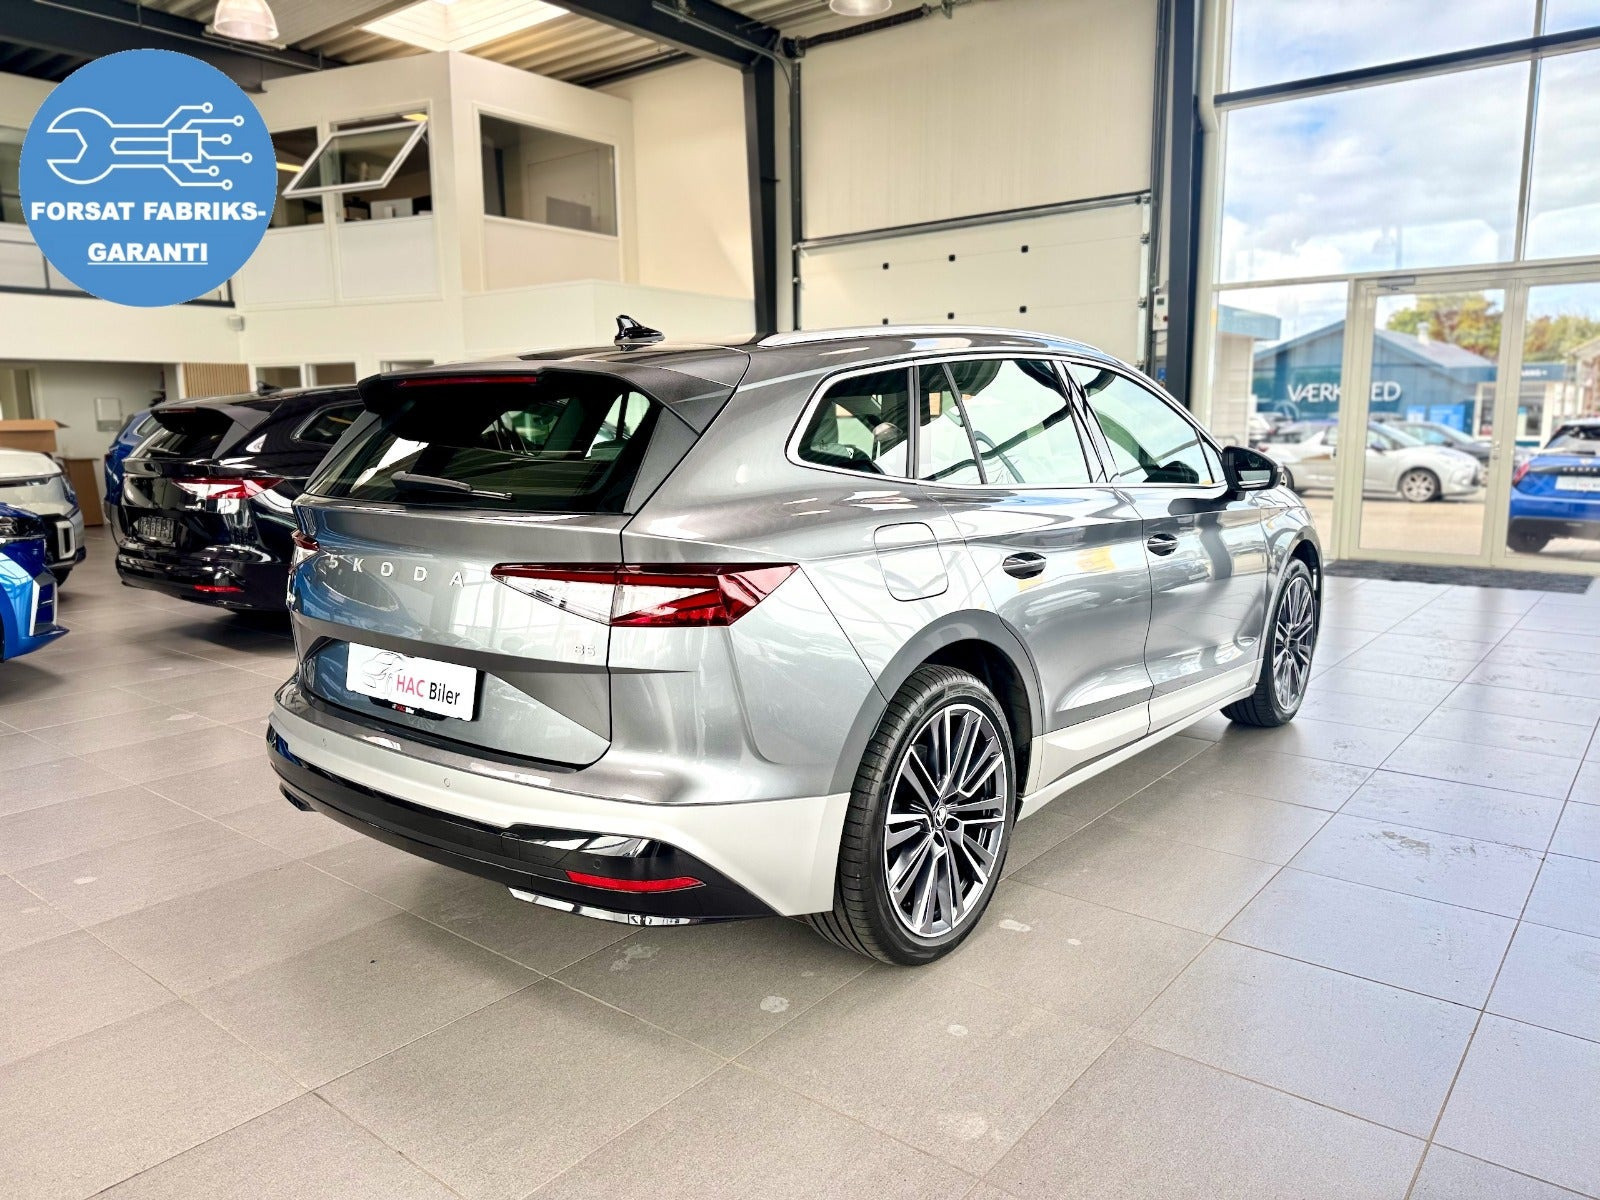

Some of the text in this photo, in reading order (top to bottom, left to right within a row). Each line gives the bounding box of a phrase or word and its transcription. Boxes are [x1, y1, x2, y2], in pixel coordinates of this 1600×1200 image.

[1287, 381, 1402, 403] VÆRKED
[396, 674, 461, 706] HAC Biler
